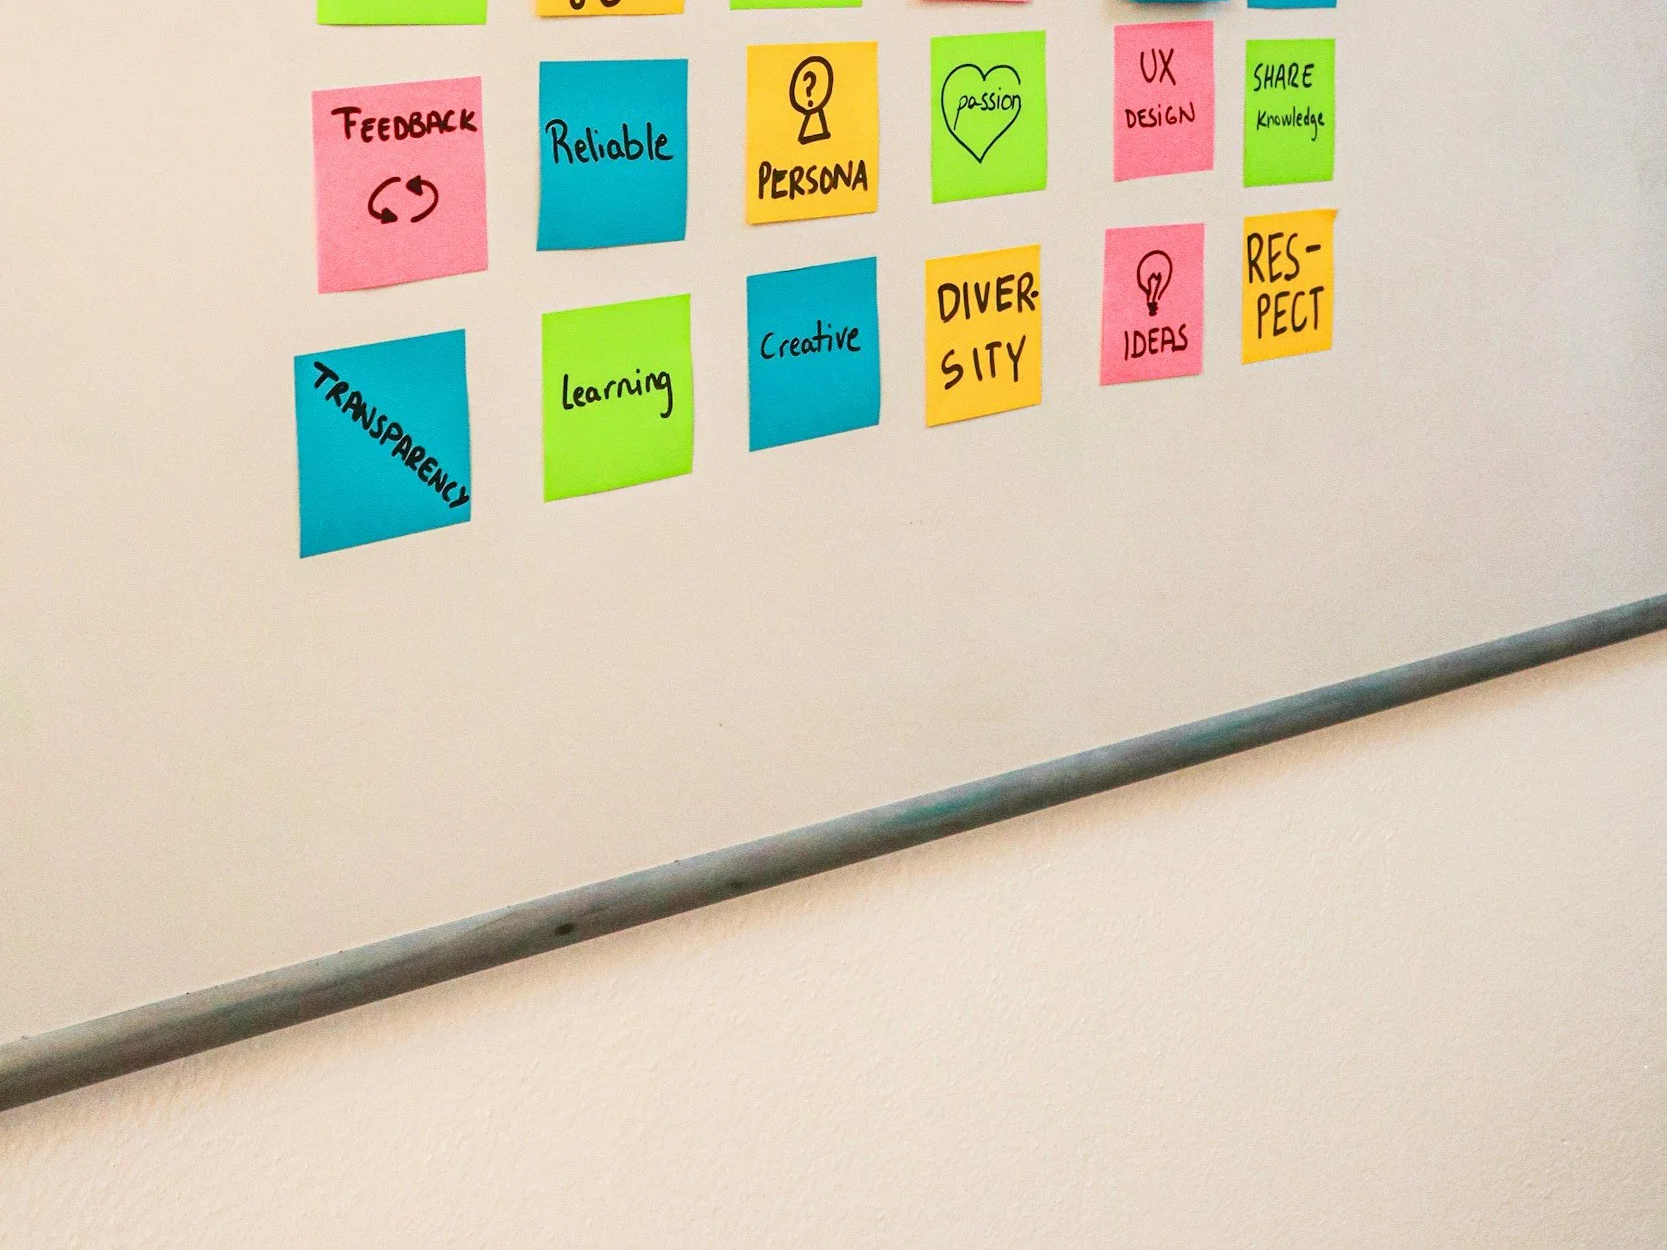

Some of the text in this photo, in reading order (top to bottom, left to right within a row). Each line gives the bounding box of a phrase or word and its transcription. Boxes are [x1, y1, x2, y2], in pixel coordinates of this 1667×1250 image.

[1140, 48, 1176, 86] UX
[1254, 63, 1315, 92] SHARE
[545, 119, 673, 165] Reliable
[758, 160, 868, 200] PERSONA
[1247, 232, 1321, 283] RES-
[1257, 286, 1324, 339] PECT
[940, 335, 1028, 390] SITY
[1124, 324, 1188, 361] IDEAS
[313, 362, 470, 509] TRANSPARENCY
